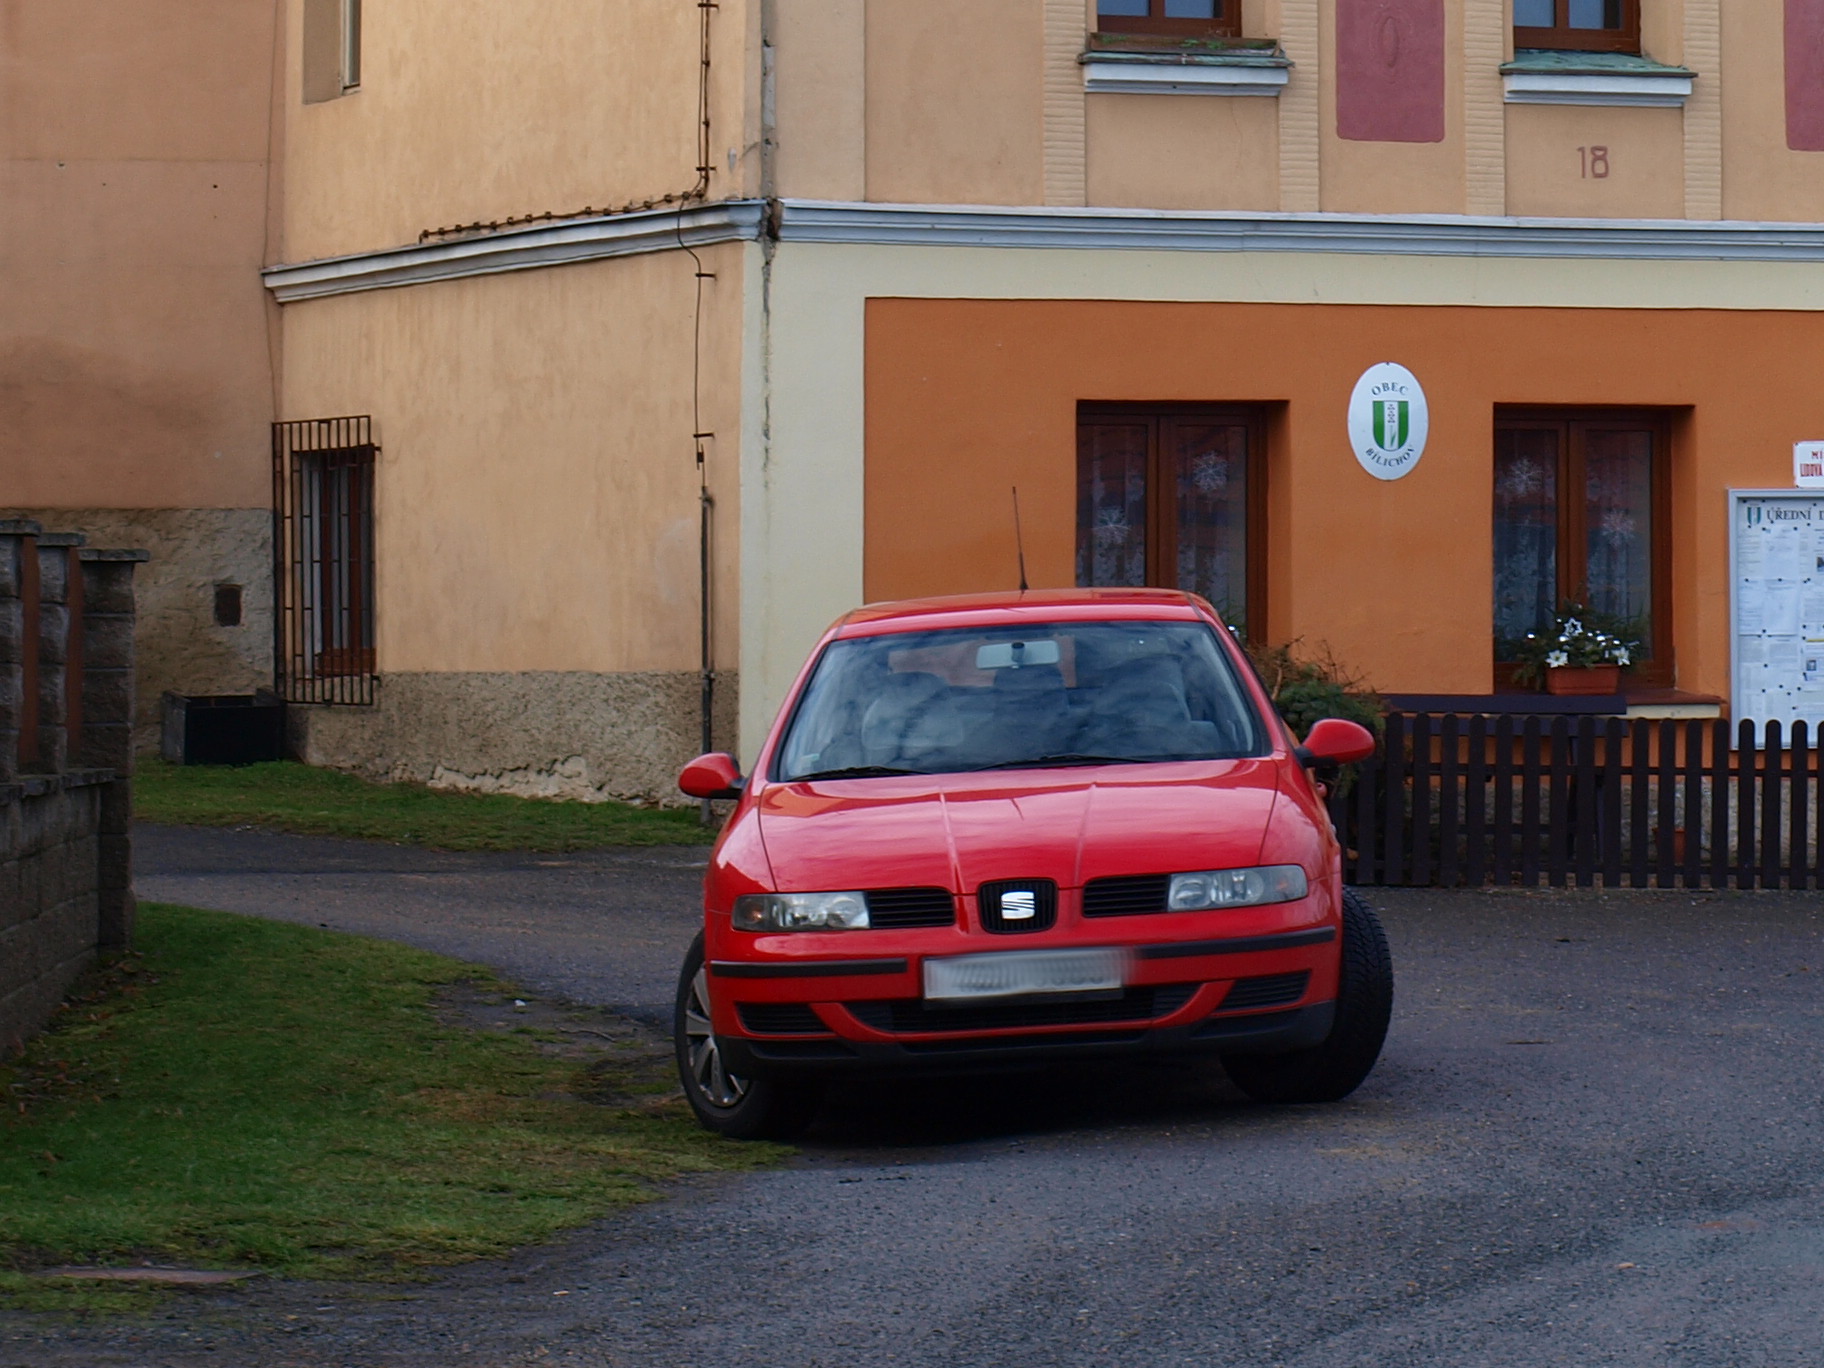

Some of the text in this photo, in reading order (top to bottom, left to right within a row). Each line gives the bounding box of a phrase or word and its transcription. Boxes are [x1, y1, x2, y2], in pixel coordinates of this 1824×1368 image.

[1576, 145, 1610, 179] 18
[1371, 381, 1409, 396] OBEC
[1365, 445, 1416, 467] BÍLICHOV
[1766, 506, 1812, 521] ÚŘEDNÍ
